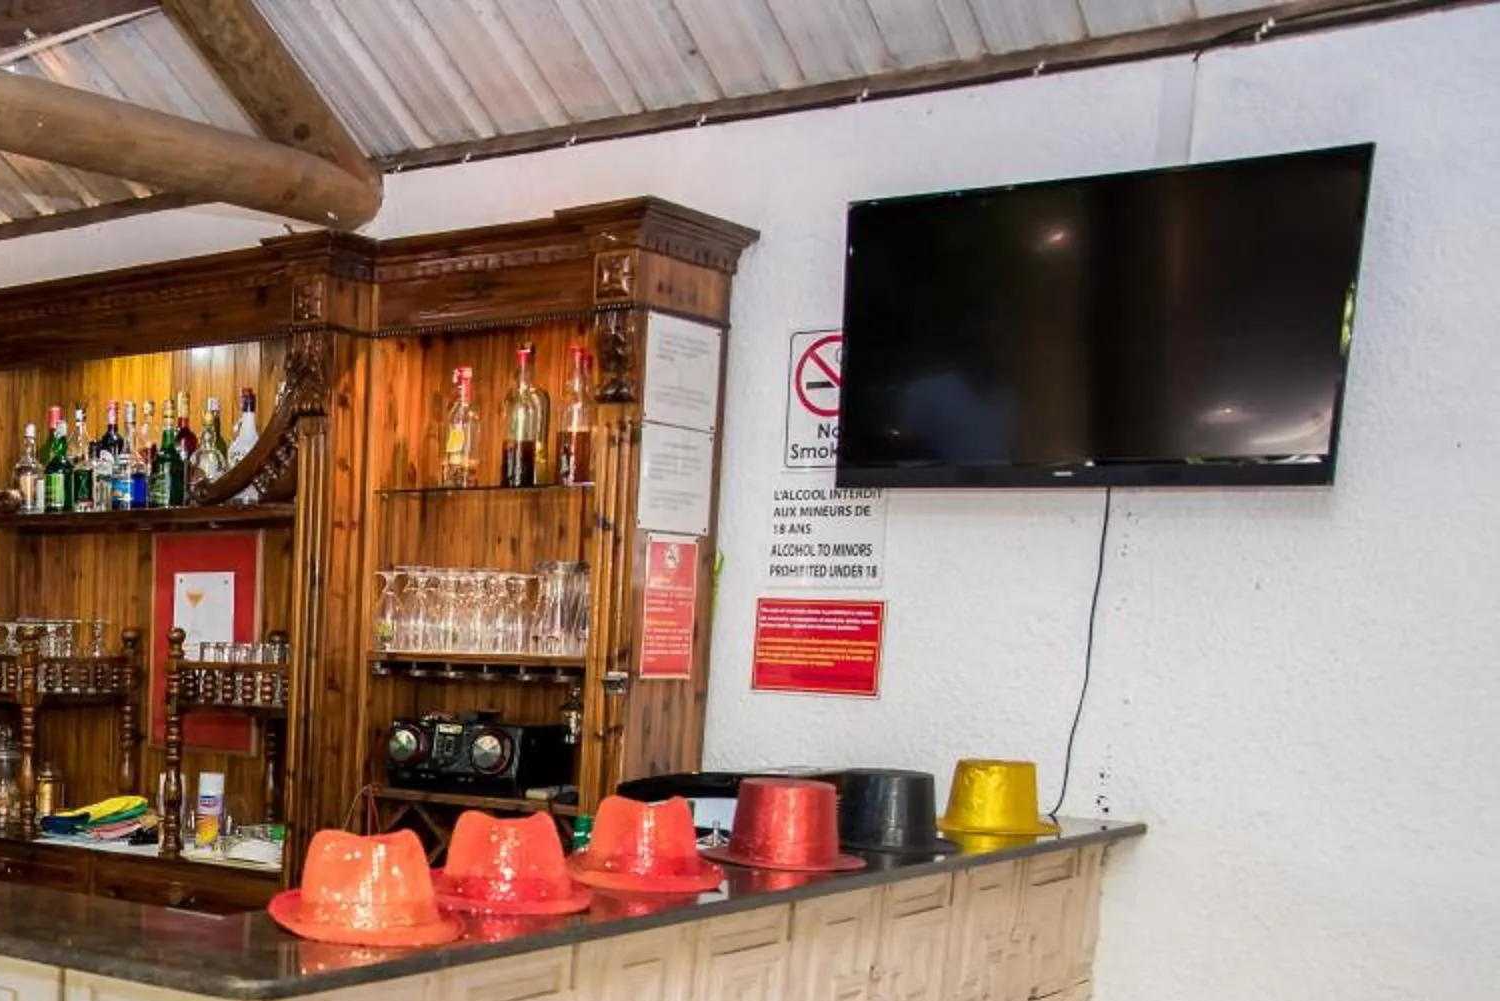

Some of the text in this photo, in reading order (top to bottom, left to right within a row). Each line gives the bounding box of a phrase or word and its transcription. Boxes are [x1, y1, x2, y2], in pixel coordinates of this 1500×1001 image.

[817, 424, 841, 438] No
[790, 443, 837, 459] Smok
[774, 489, 826, 501] L'ALCOOL
[773, 505, 872, 517] AUX MINEURS DE
[773, 524, 812, 535] 18 ANS
[770, 544, 873, 557] ALCOHOL TO MINORS
[829, 565, 863, 578] UNDER
